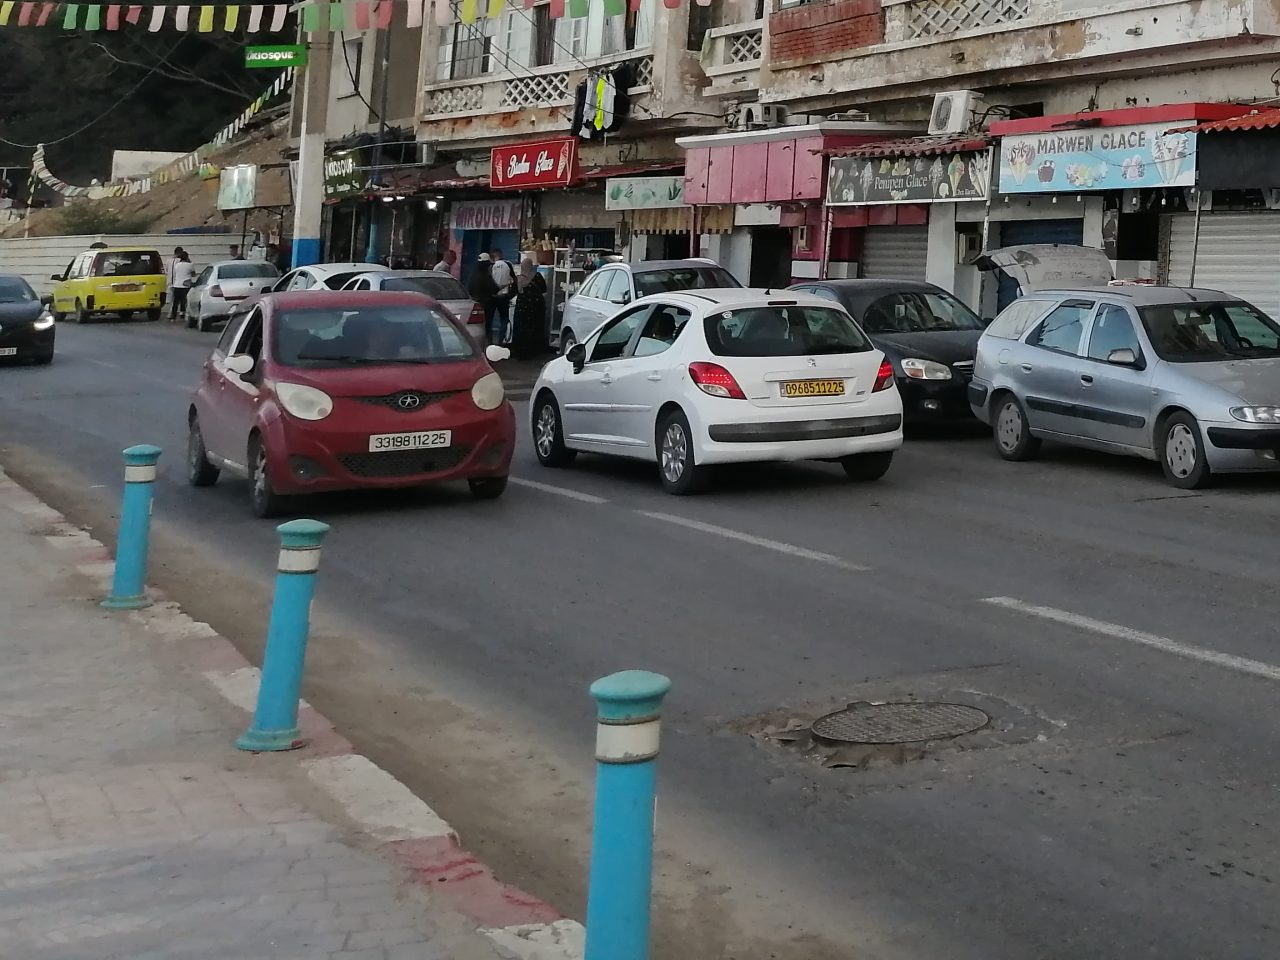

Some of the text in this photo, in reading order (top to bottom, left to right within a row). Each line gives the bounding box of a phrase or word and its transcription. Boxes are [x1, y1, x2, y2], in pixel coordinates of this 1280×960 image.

[1037, 130, 1146, 155] MARWEN GLACE
[906, 174, 928, 187] Glace
[785, 382, 845, 395] 0968511225
